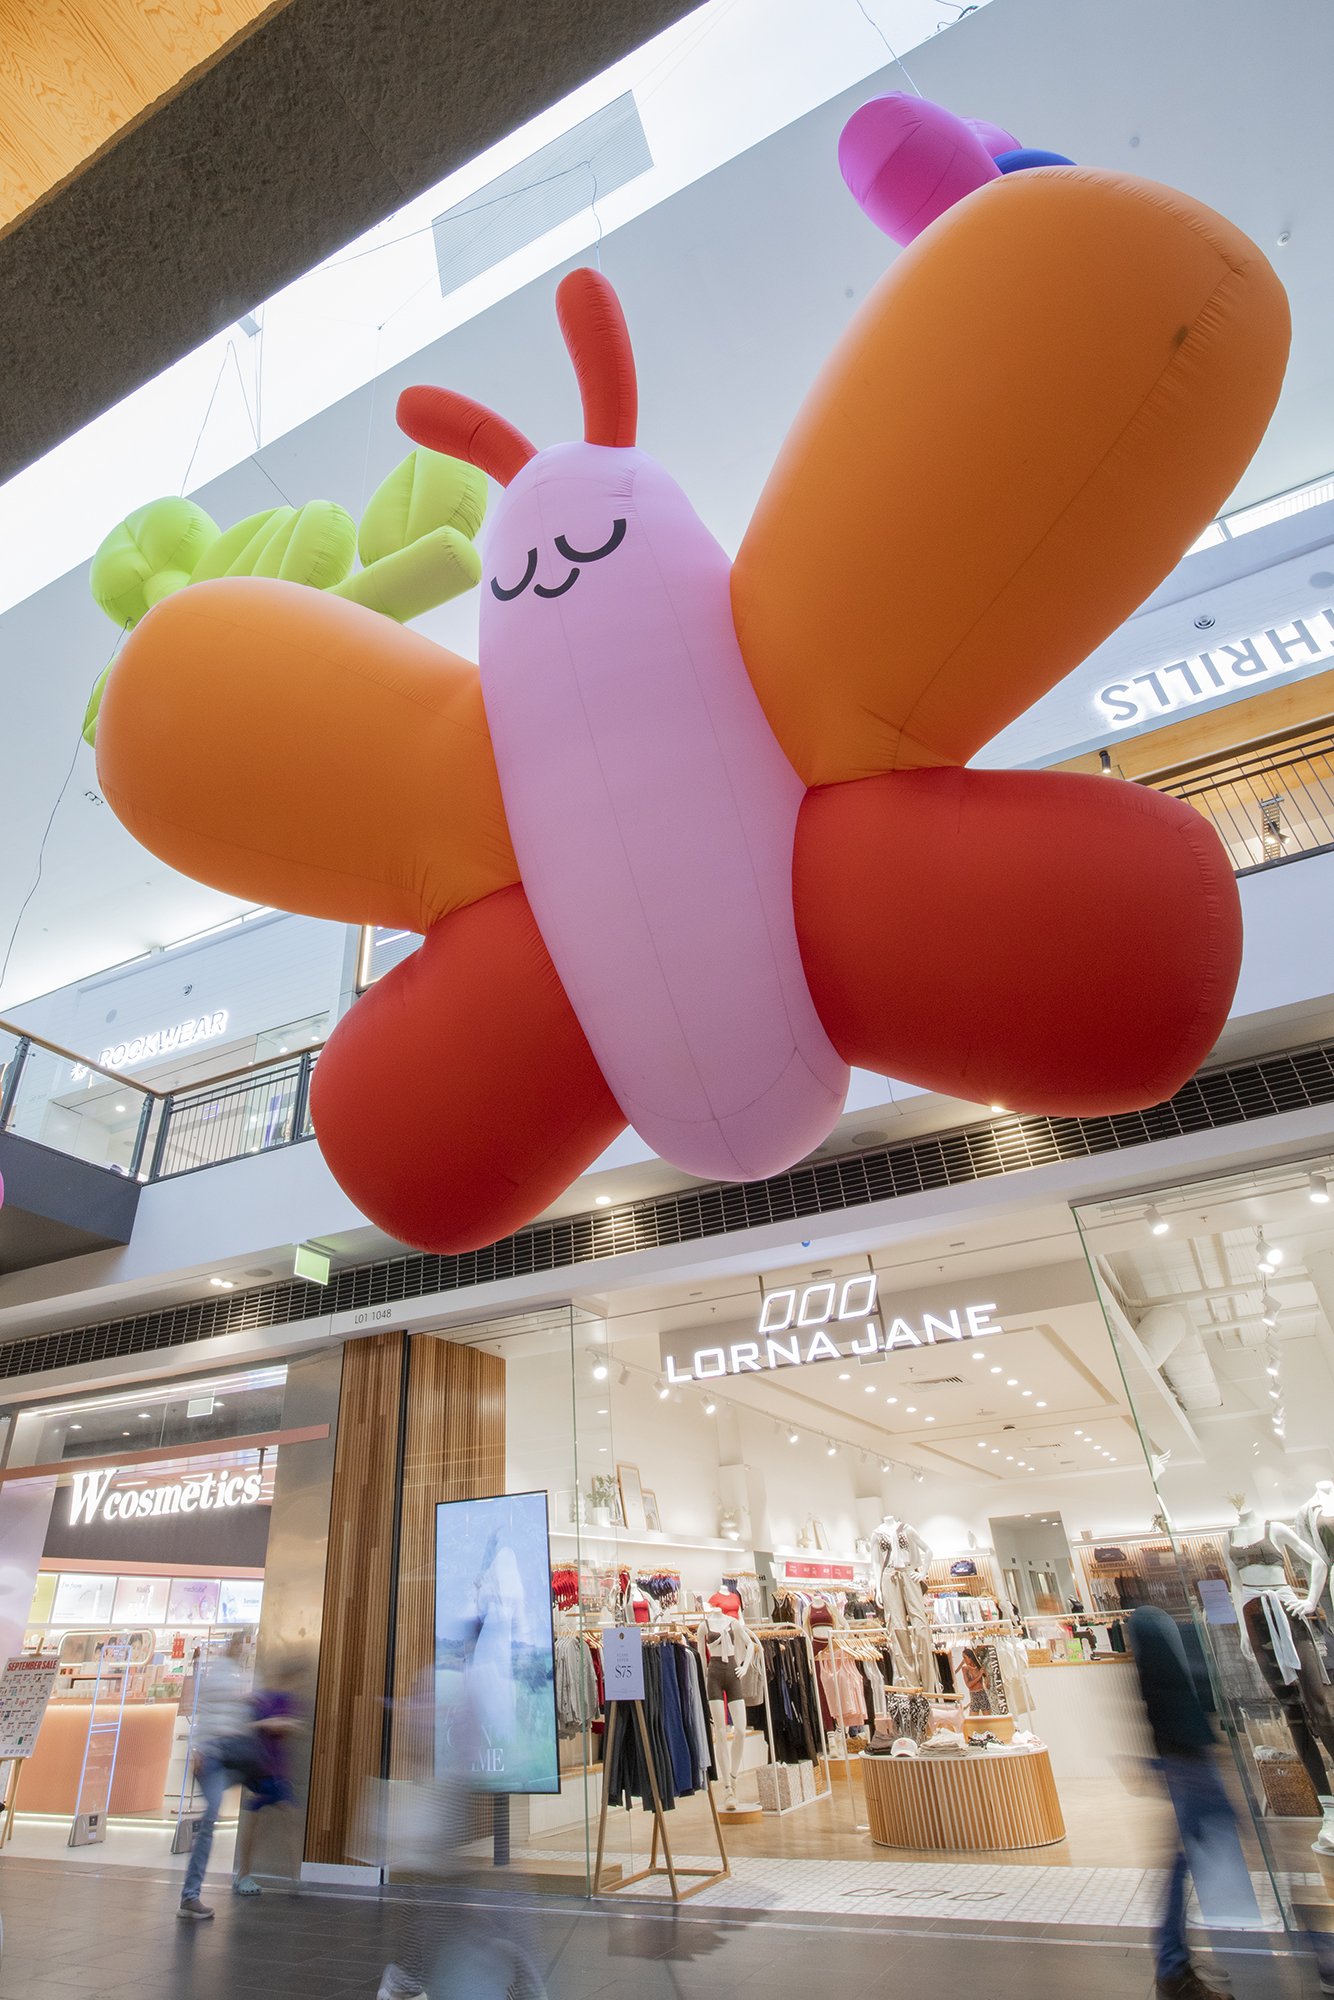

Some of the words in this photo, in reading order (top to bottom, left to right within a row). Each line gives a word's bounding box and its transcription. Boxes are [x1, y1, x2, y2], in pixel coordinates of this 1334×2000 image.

[98, 1010, 227, 1069] ROCKWEAR
[372, 1308, 392, 1321] 1048
[665, 1330, 842, 1384] LORNA
[850, 1303, 1003, 1355] JANE
[7, 1661, 42, 1671] SEPTEMBER
[42, 1660, 58, 1670] SALE
[614, 1664, 633, 1679] $75
